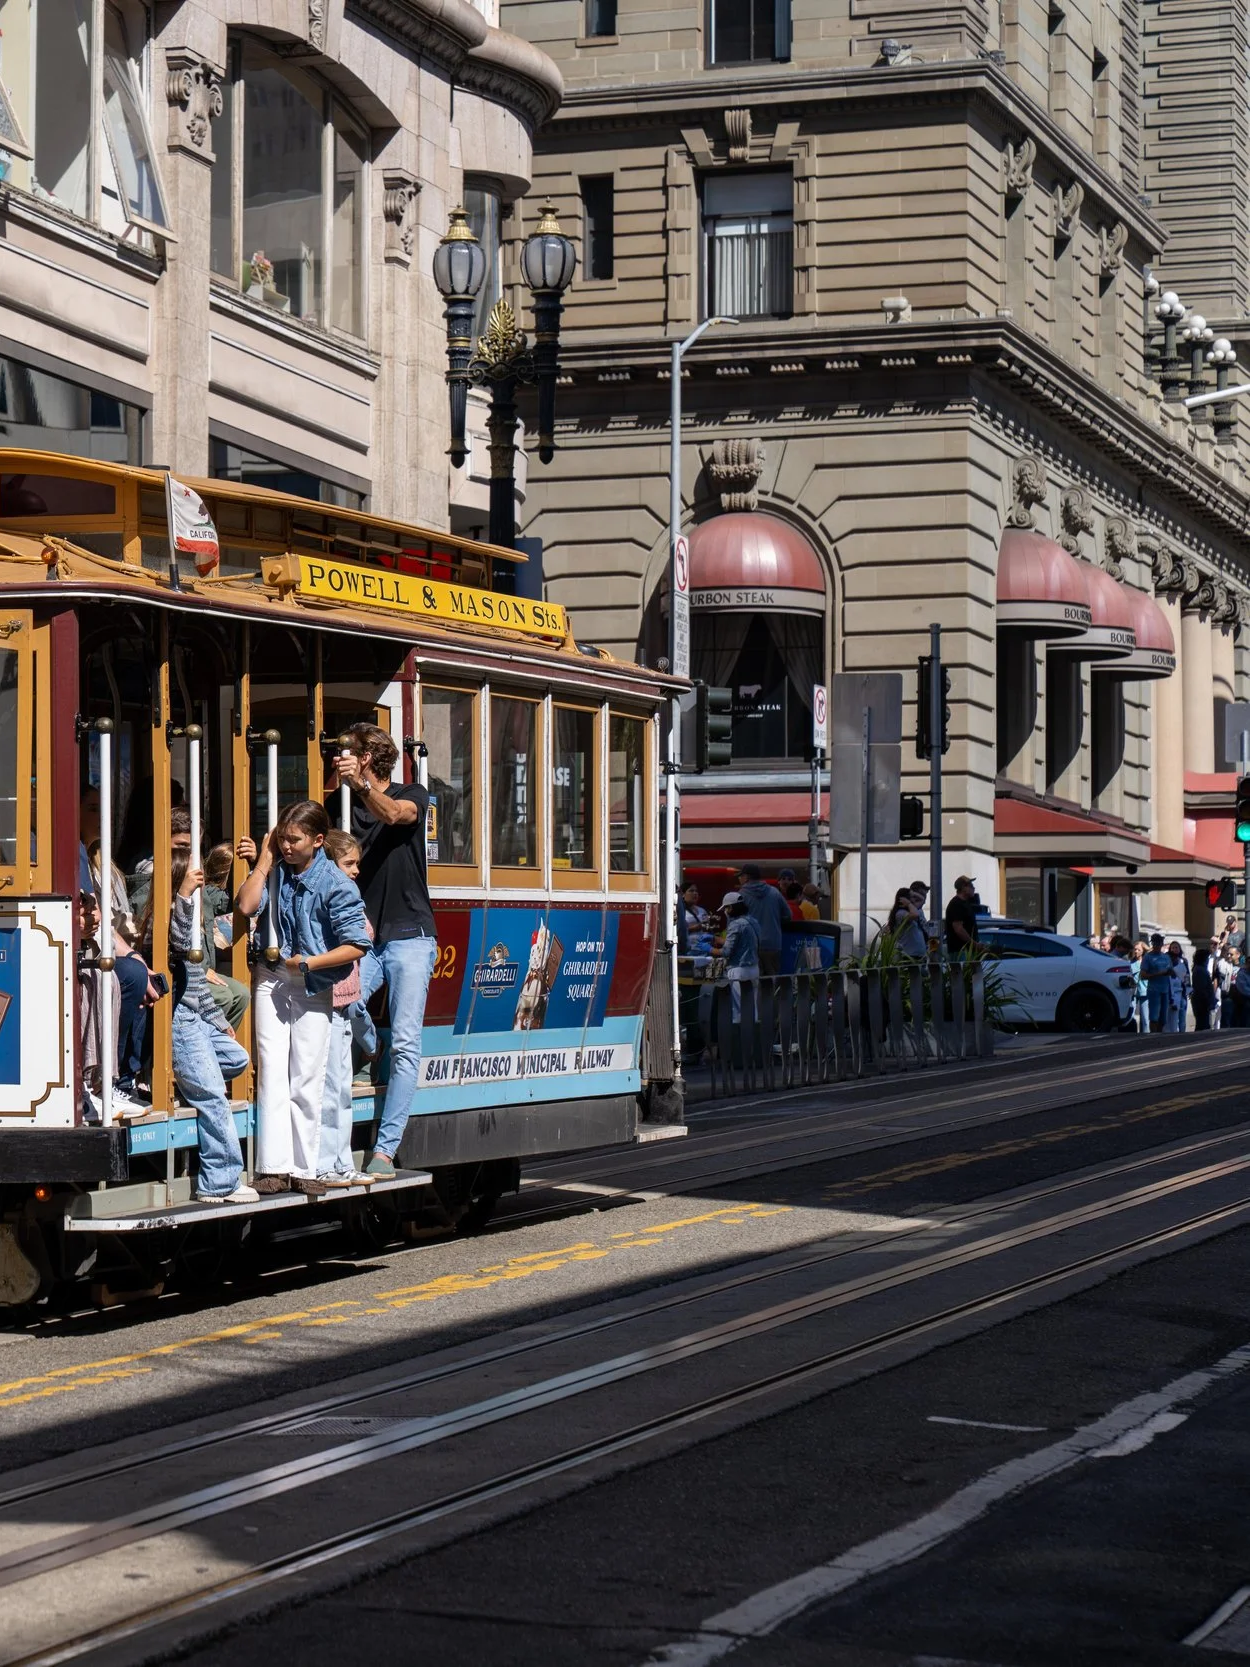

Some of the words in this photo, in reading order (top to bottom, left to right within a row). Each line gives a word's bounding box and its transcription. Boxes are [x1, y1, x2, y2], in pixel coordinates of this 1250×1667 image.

[307, 564, 410, 606] POWELL
[422, 585, 438, 610] &
[449, 590, 527, 625] MASON
[532, 605, 562, 631] Sts.
[690, 592, 731, 606] URBON
[736, 592, 775, 604] STEAK
[757, 703, 781, 711] STEAK
[575, 941, 586, 952] HOP
[587, 941, 595, 952] ON
[474, 968, 517, 983] GHIRARDELLI
[563, 961, 608, 976] GHIRARDELLI
[425, 1058, 449, 1081] SAN
